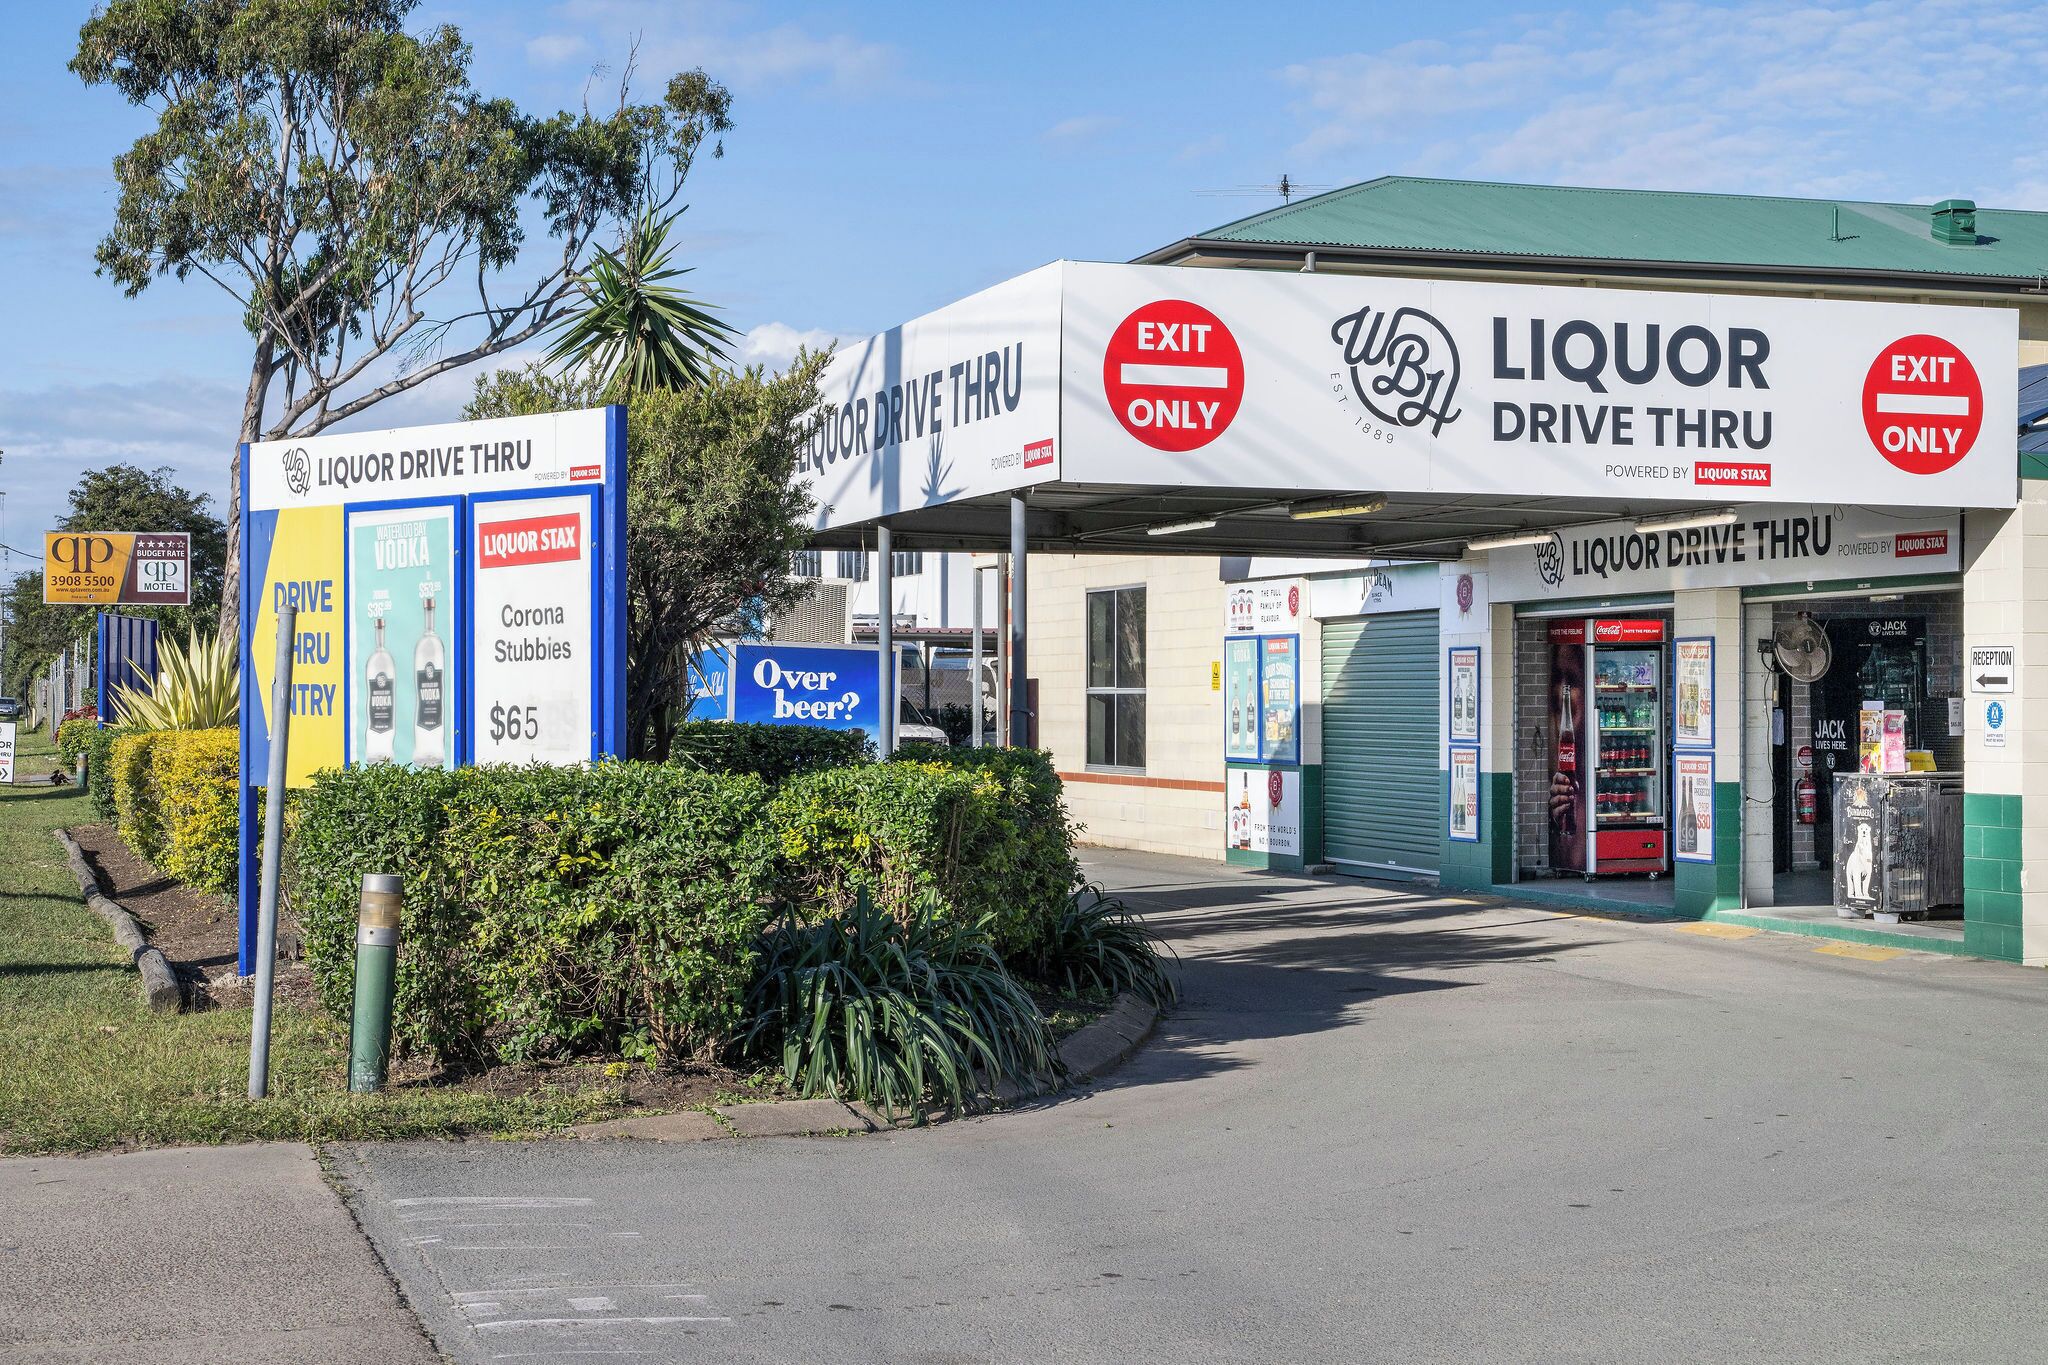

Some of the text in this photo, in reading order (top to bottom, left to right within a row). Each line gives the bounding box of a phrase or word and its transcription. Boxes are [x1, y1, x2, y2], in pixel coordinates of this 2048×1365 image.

[1137, 321, 1212, 353] EXIT
[1493, 316, 1771, 394] LIQUOR
[1891, 354, 1956, 384] EXIT
[797, 342, 1022, 477] LIQUOR DRIVE THRU
[1127, 398, 1221, 430] ONLY
[1330, 372, 1394, 444] EST. 1889
[1494, 402, 1772, 450] DRIVE THRU
[1882, 425, 1963, 455] ONLY
[318, 452, 394, 489] LIQUOR
[400, 446, 464, 480] DRIVE
[470, 440, 532, 474] THRU
[991, 450, 1022, 470] POWERED BY
[1024, 445, 1053, 464] LIQUOR STAX
[534, 471, 568, 481] POWERED BY
[571, 467, 600, 480] LIQUOR STAX
[1605, 464, 1689, 480] POWERED BY
[1698, 466, 1768, 483] LIQUOR STAX
[376, 522, 427, 540] WATERLOO BAY
[484, 526, 576, 559] LIQUOR STAX
[52, 537, 114, 573] qp
[374, 536, 430, 571] VODKA
[1572, 532, 1660, 579] LIQUOR
[1666, 525, 1746, 567] DRIVE
[1752, 514, 1832, 561] THRU
[1838, 540, 1892, 557] POWERED BY
[1897, 535, 1946, 554] LIQUOR STAX
[51, 576, 114, 586] 3908 5500
[1374, 568, 1392, 597] BEAM
[274, 580, 333, 613] DRIVE
[501, 604, 564, 628] Corona
[1882, 621, 1907, 631] JACK
[276, 632, 330, 664] HRU
[494, 637, 572, 663] Stubbies
[1972, 651, 2012, 666] RECEPTION
[754, 658, 836, 691] Over
[371, 695, 392, 707] VODKA
[420, 689, 440, 700] VODKA
[772, 688, 860, 721] beer?
[490, 701, 538, 746] $65
[1815, 720, 1846, 739] JACK
[1815, 741, 1848, 750] LIVES HERE.
[1681, 763, 1697, 773] LIQUOR
[1268, 824, 1276, 832] THE
[1697, 814, 1710, 830] $30
